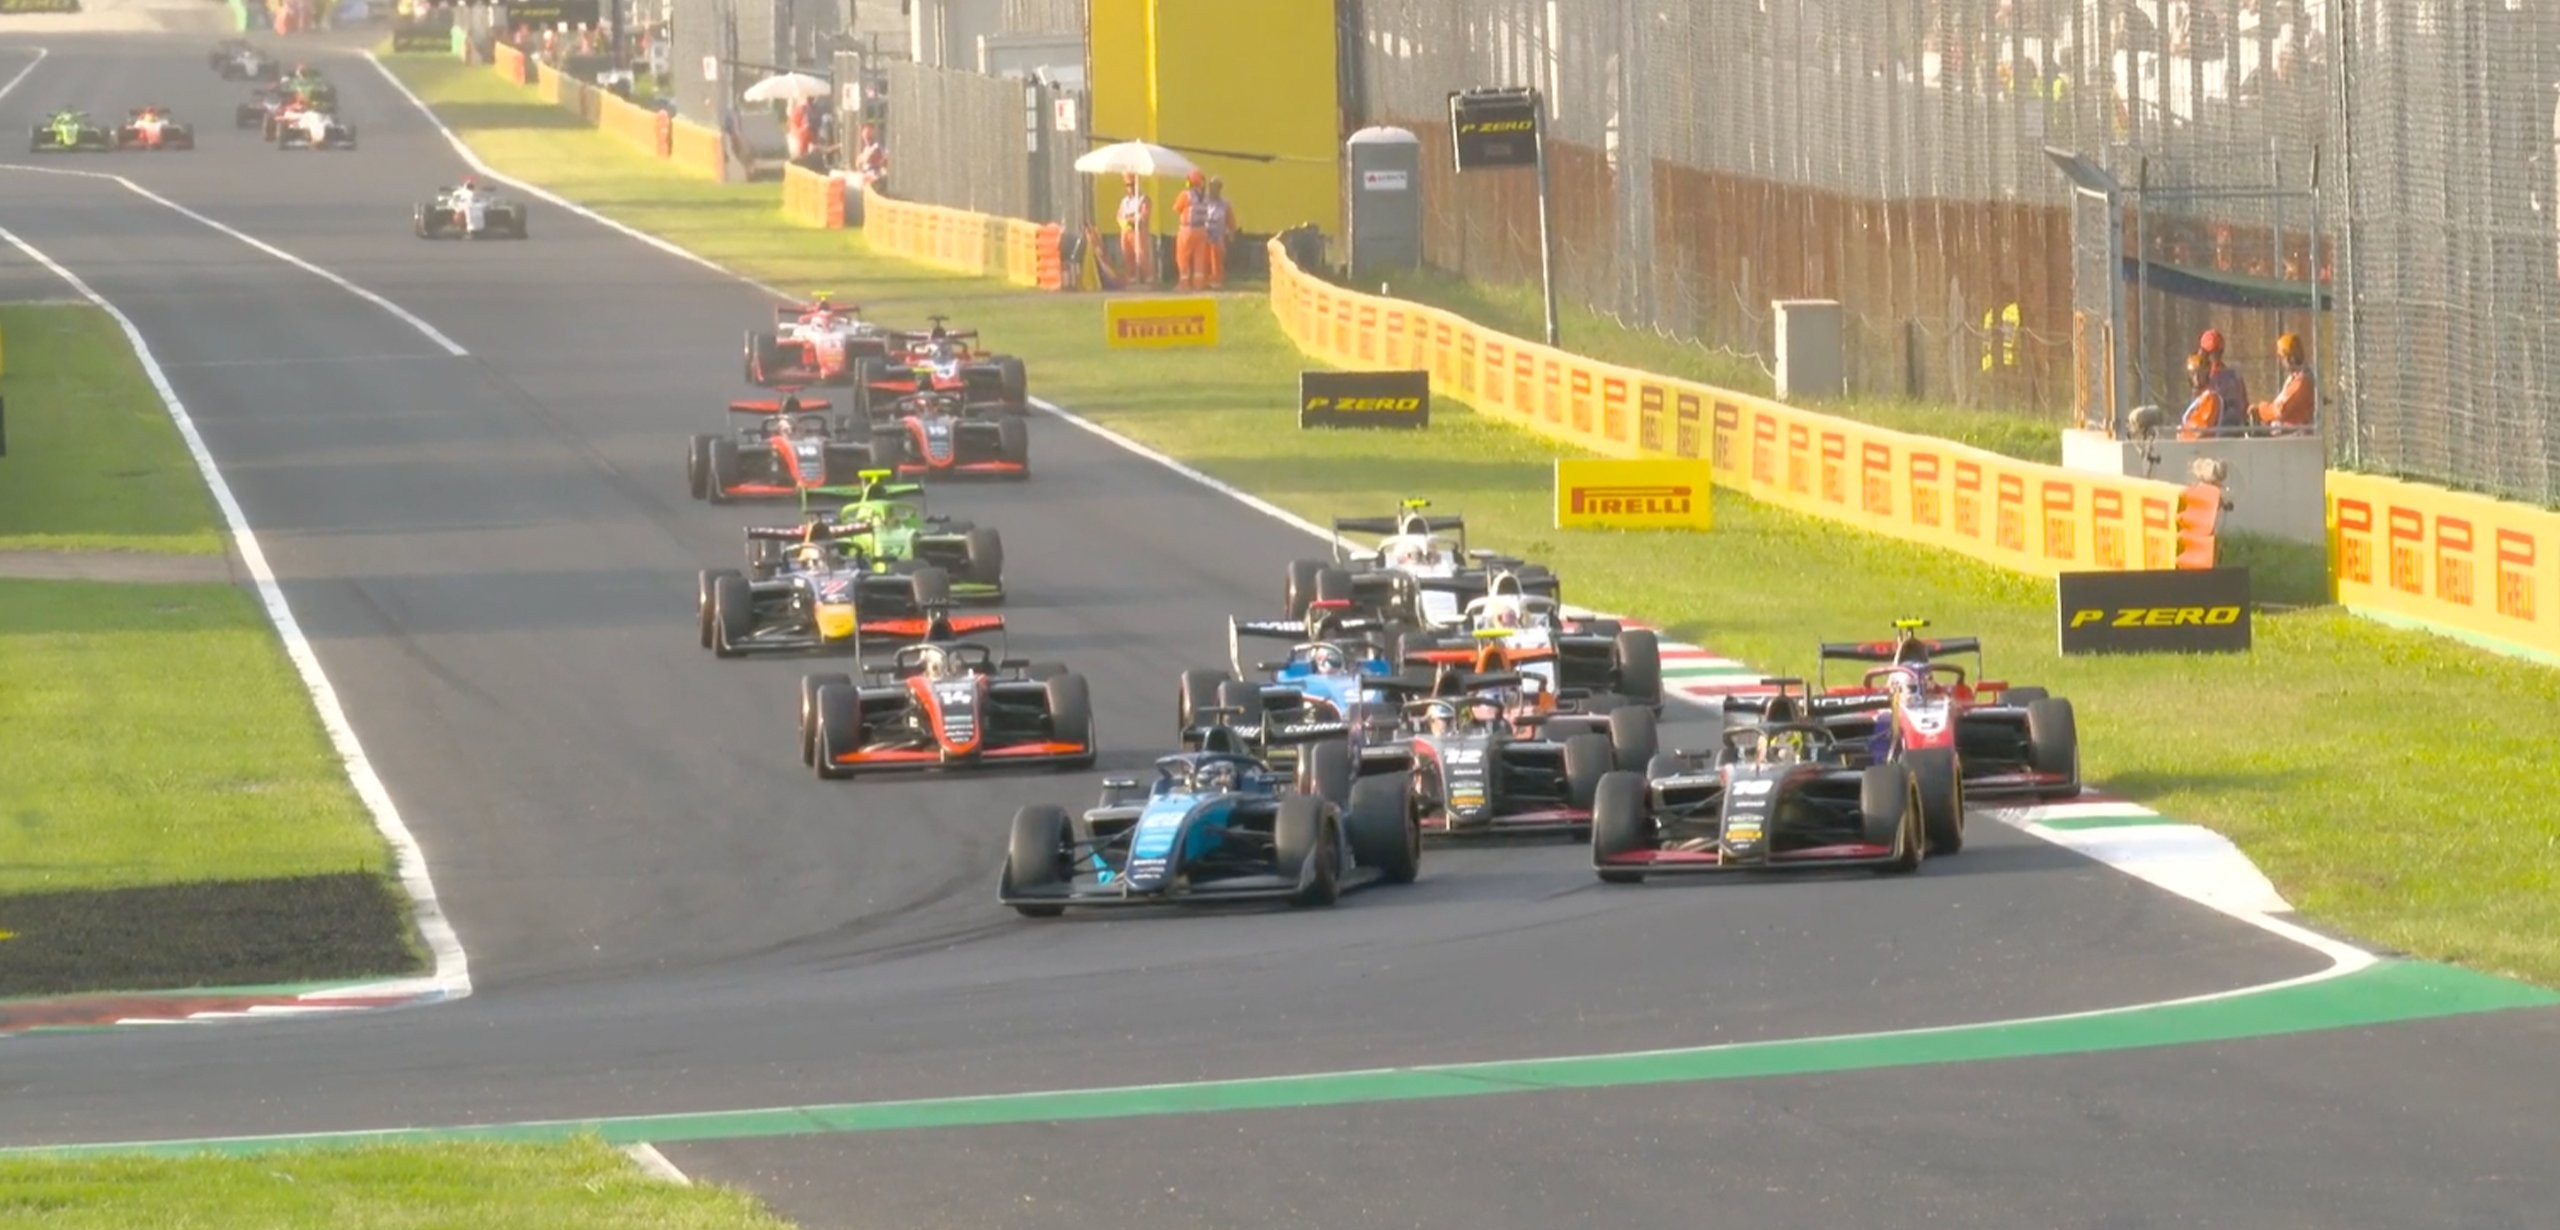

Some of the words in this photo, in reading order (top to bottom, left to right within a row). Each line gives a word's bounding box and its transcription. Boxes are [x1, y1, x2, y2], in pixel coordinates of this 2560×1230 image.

[1461, 124, 1476, 133] P
[1480, 121, 1533, 132] ZERO
[1118, 315, 1204, 337] PIRELLI
[1306, 398, 1329, 410] P
[1333, 397, 1420, 411] ZERO
[1571, 486, 1692, 514] PIRELLI
[2070, 610, 2104, 628] P
[2112, 607, 2240, 626] ZERO
